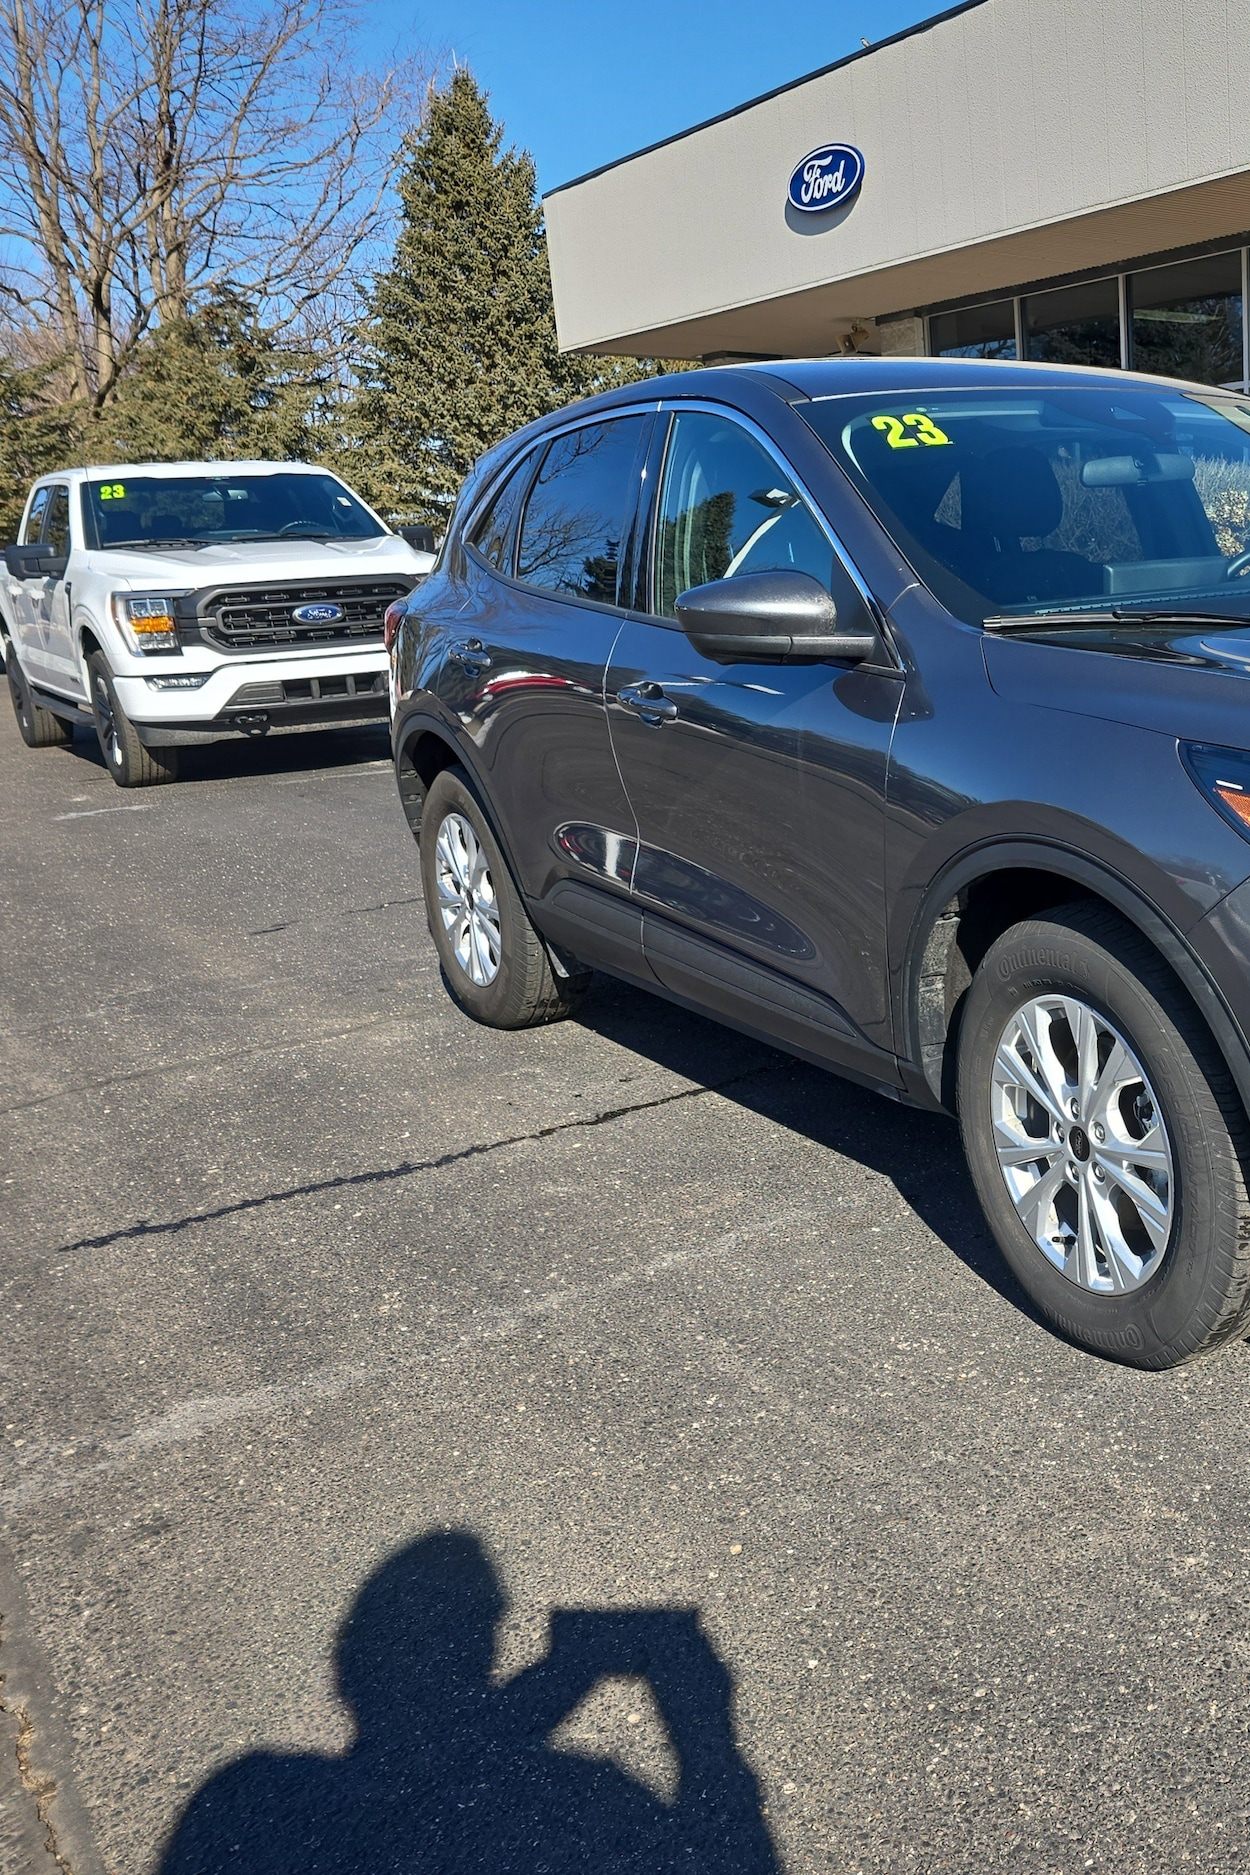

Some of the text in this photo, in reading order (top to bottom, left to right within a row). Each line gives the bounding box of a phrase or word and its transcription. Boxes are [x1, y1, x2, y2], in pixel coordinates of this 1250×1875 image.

[801, 155, 845, 203] Ford
[871, 413, 950, 449] 23
[100, 484, 125, 500] 23
